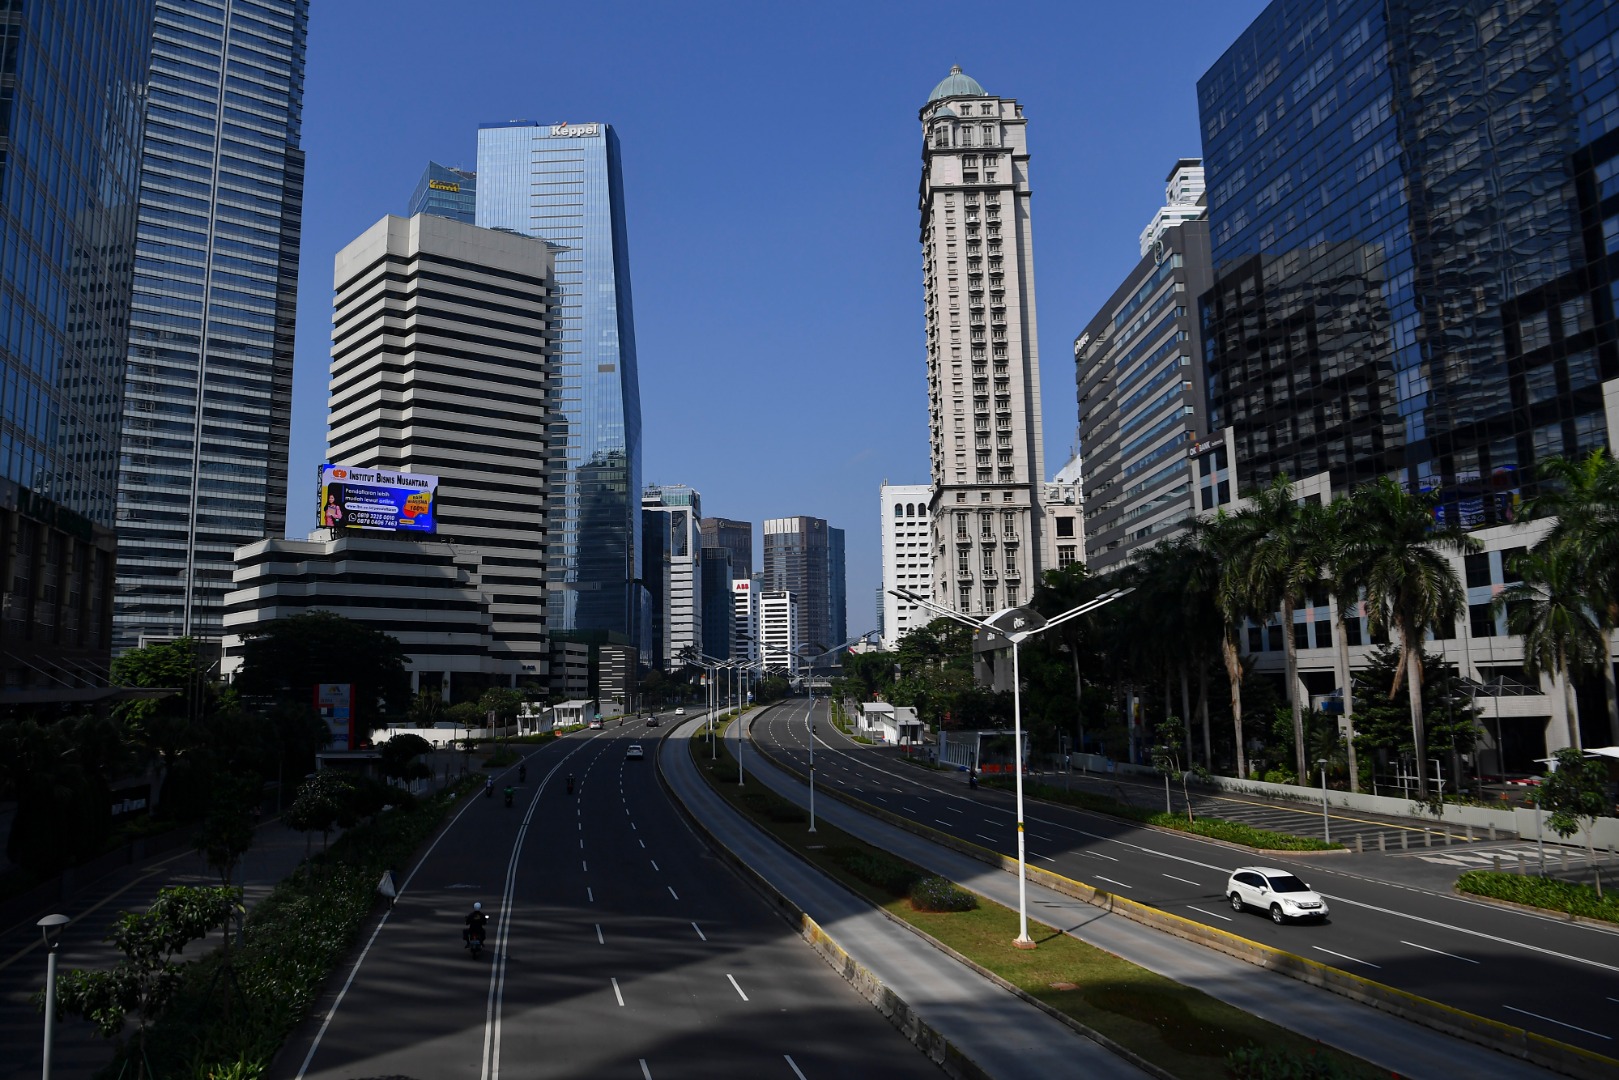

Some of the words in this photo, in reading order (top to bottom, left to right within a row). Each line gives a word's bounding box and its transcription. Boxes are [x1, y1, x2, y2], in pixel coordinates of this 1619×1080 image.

[552, 122, 596, 137] Keppel
[350, 470, 374, 482] INSTITUT
[376, 473, 394, 484] BISNIS
[396, 474, 428, 487] NUSANTARA
